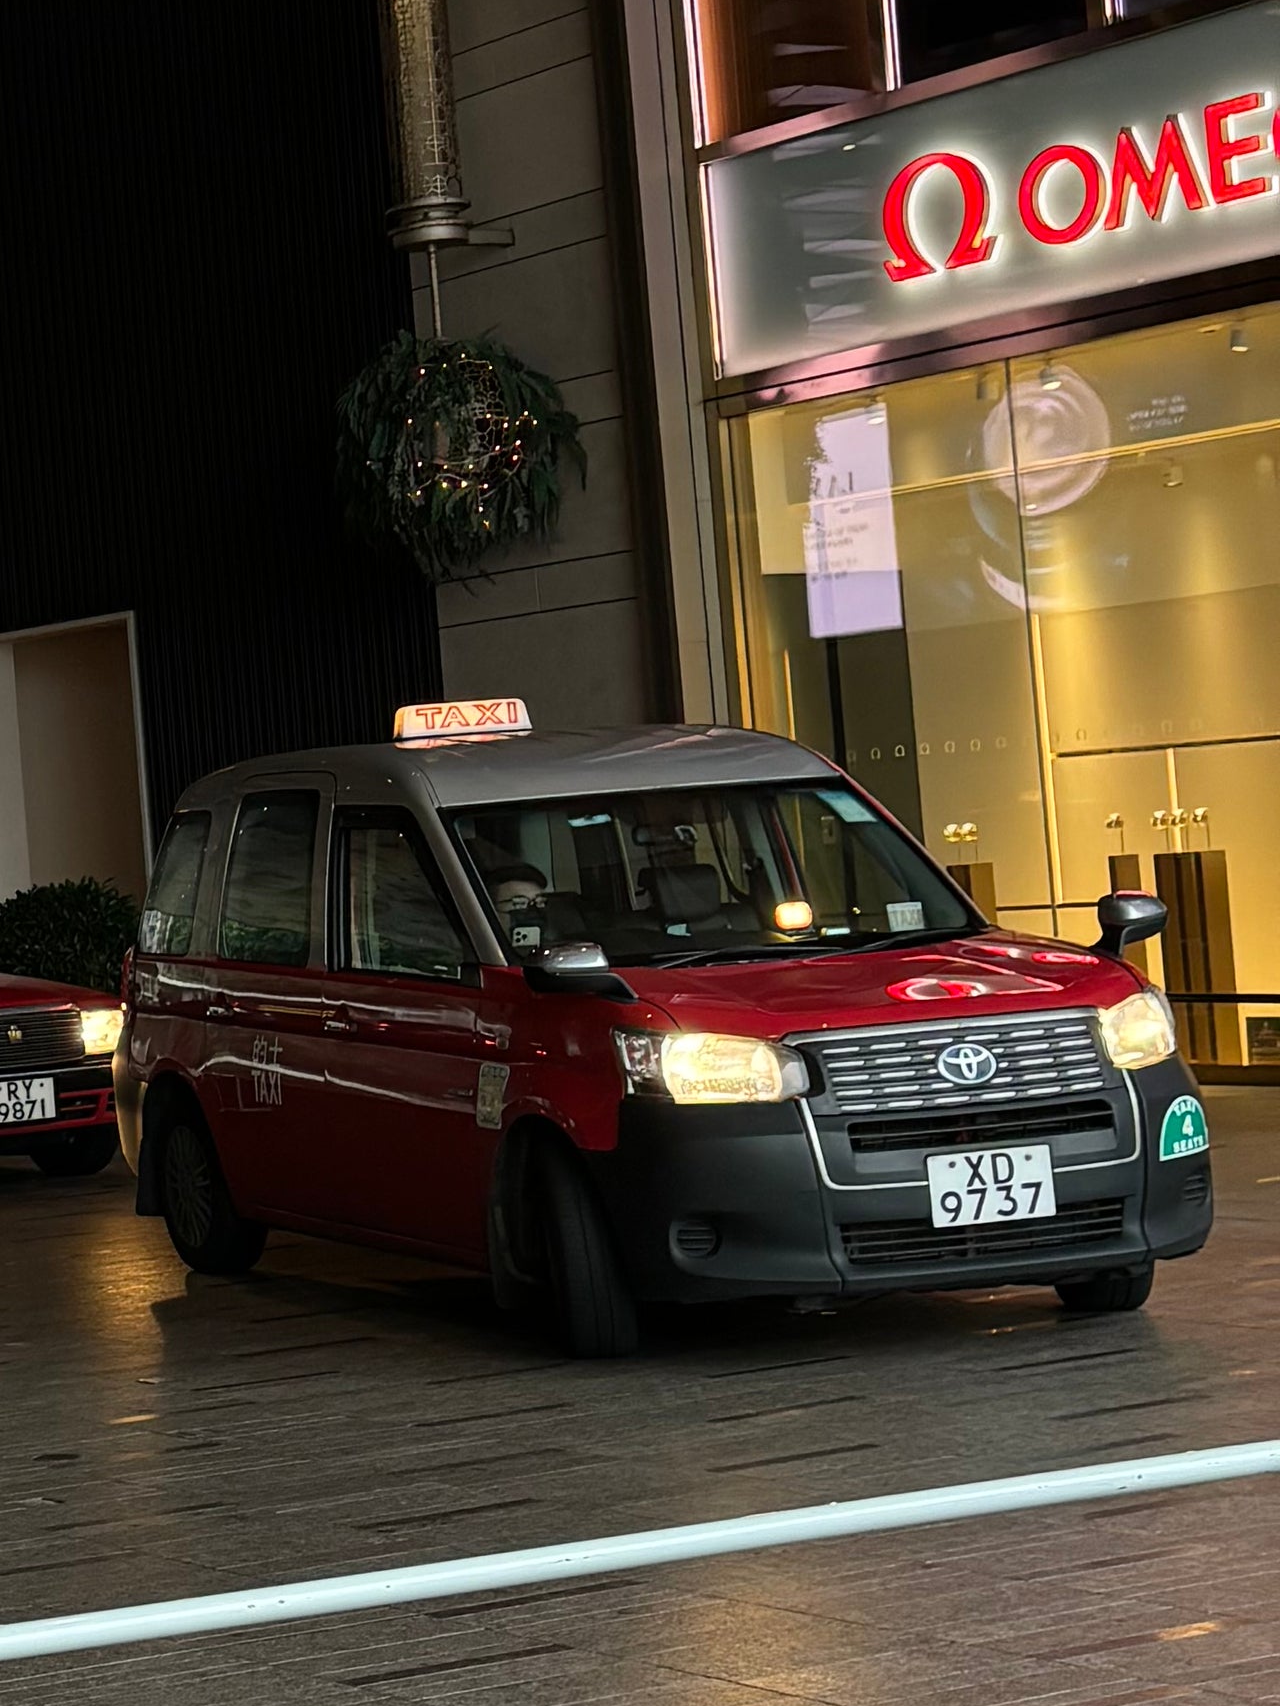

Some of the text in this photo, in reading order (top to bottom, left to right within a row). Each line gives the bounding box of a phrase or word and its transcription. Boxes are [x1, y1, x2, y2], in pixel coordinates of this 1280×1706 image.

[1018, 92, 1280, 245] OME
[416, 701, 519, 730] TAXI
[6, 1079, 33, 1101] RY
[251, 1069, 282, 1105] TAXI
[1182, 1114, 1194, 1136] 4
[1172, 1135, 1204, 1154] SEATS
[964, 1152, 1015, 1188] XD
[940, 1181, 1043, 1223] 9737
